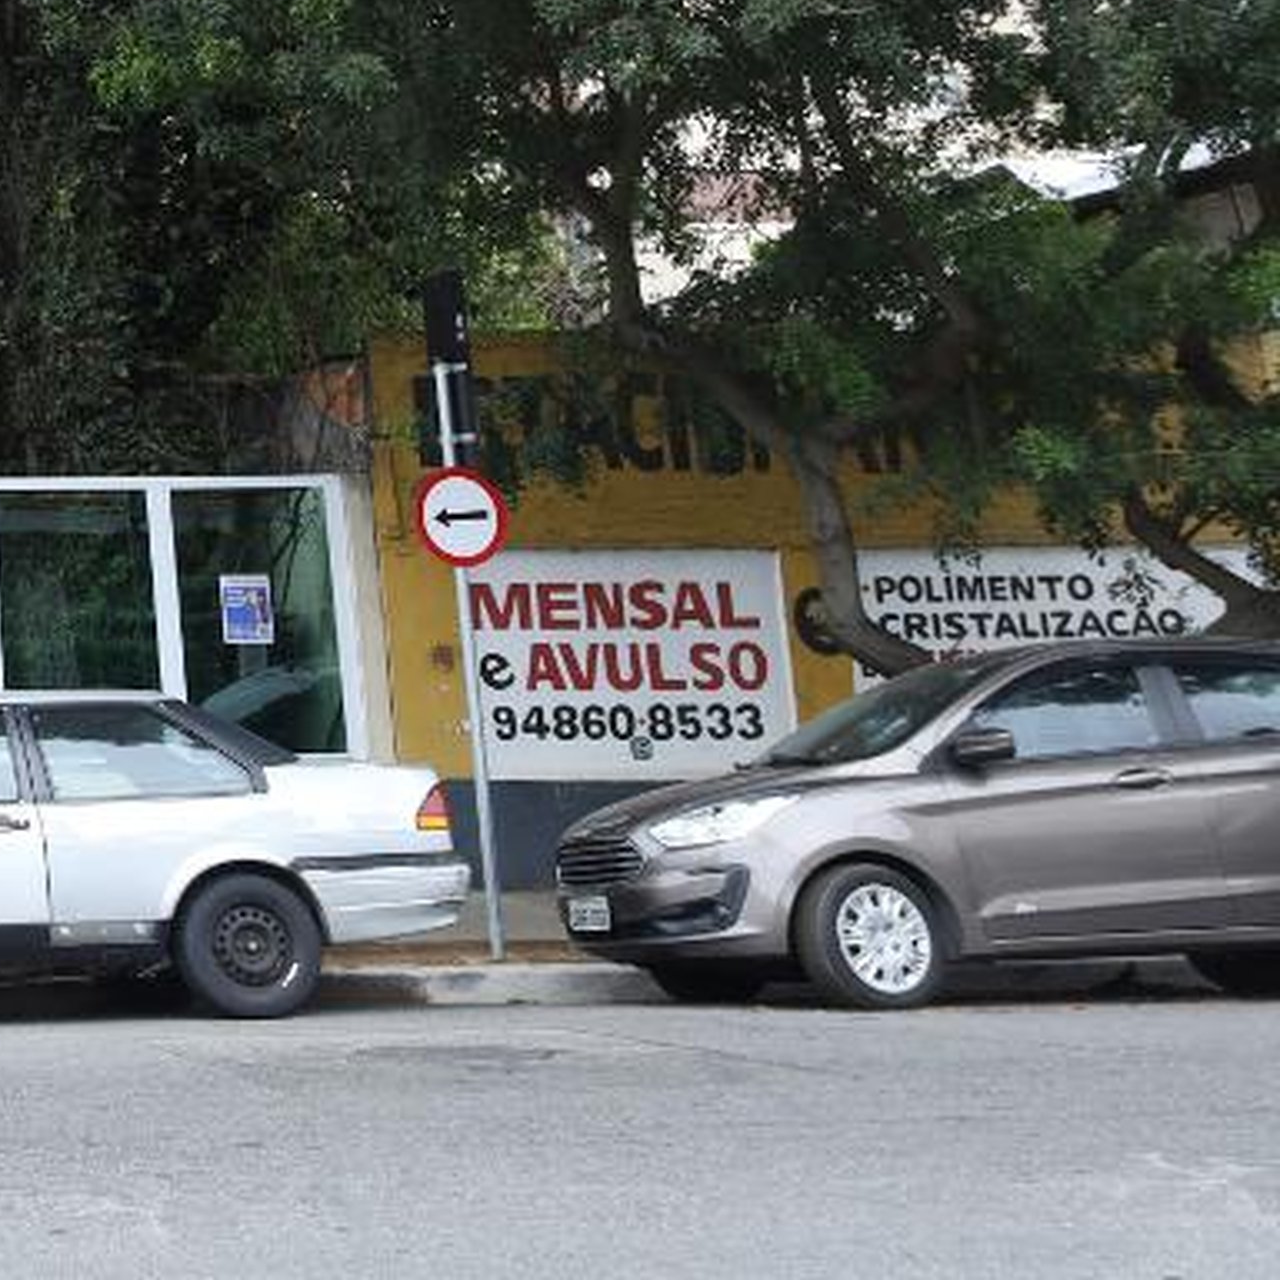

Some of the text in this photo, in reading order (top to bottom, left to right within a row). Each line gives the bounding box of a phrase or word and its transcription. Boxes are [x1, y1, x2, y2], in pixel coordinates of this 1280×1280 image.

[468, 580, 761, 631] MENSAL
[874, 574, 1094, 604] POLIMENTO
[479, 640, 769, 692] e AVULSO
